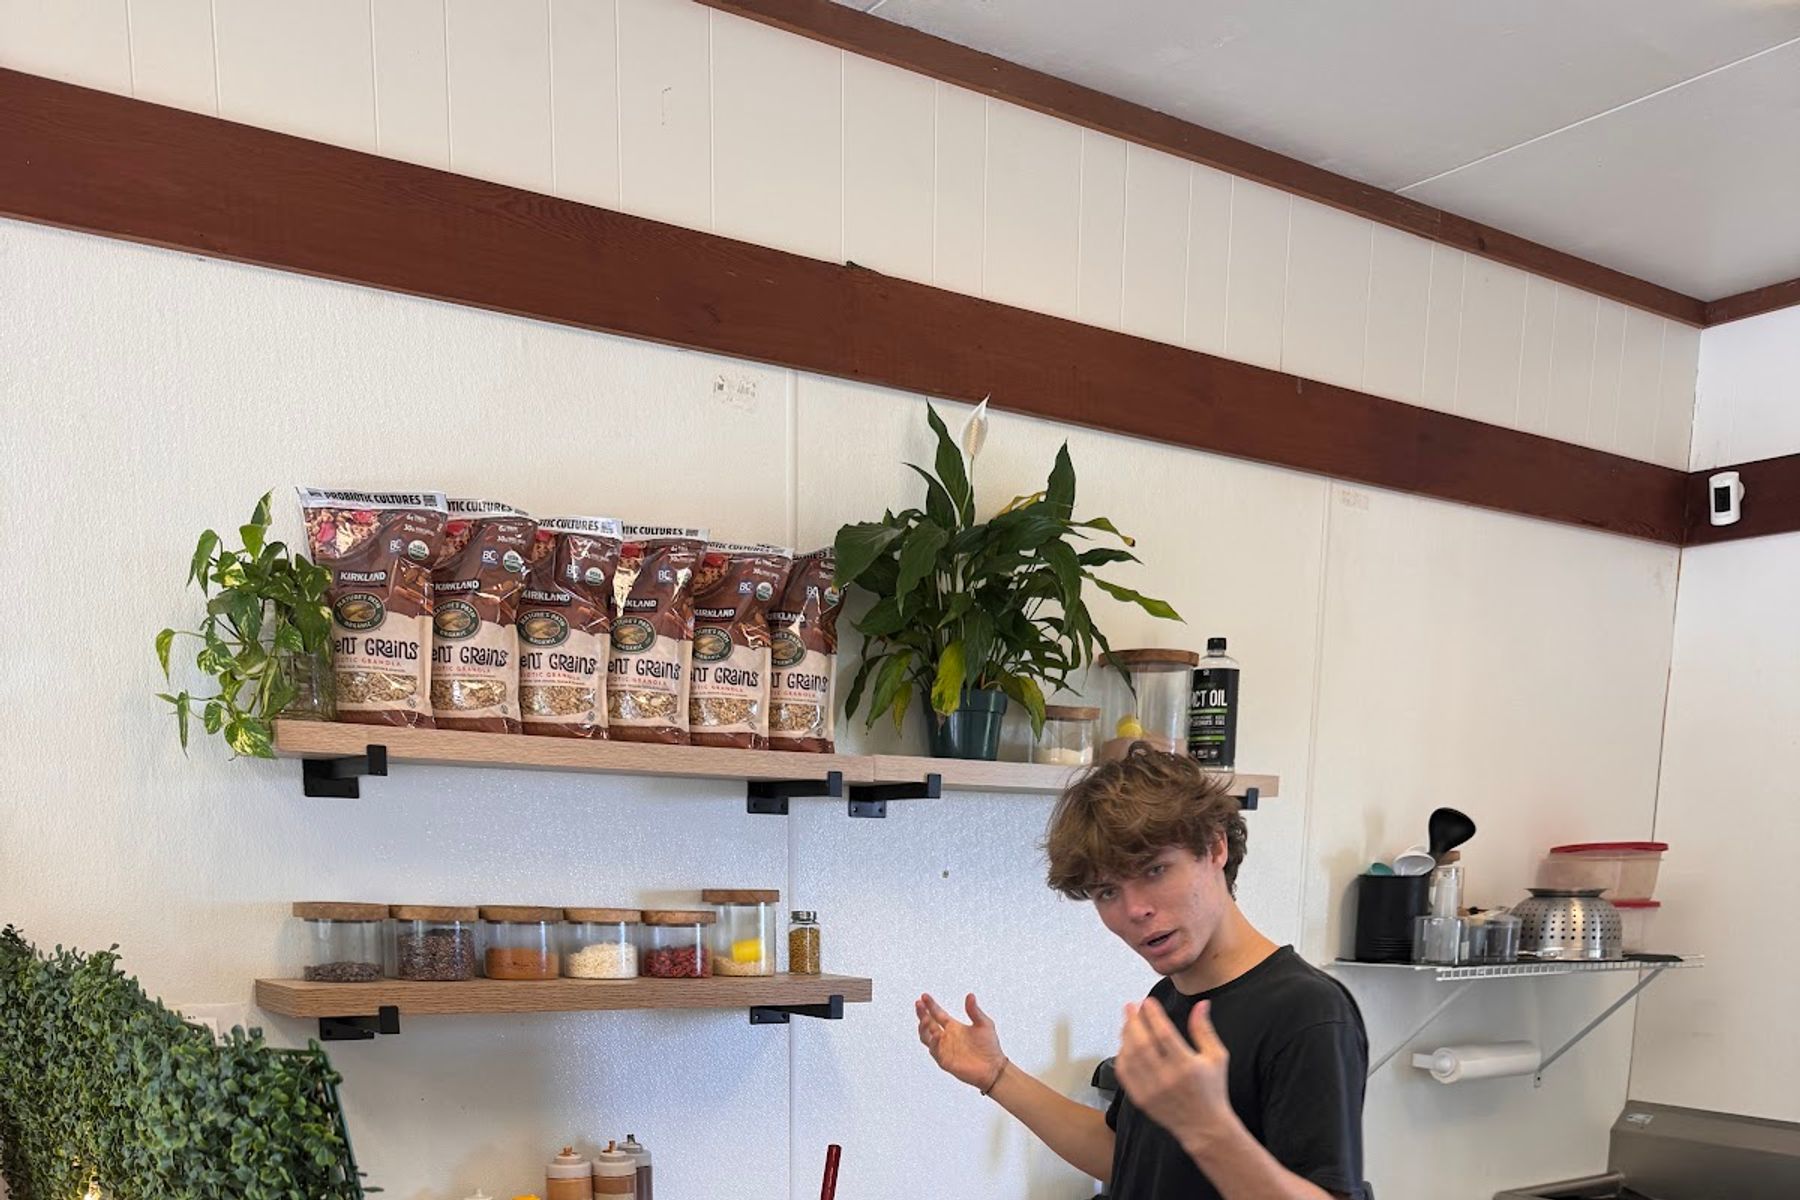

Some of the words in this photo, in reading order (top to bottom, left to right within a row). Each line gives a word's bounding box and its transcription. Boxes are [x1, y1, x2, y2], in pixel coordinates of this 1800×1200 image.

[374, 493, 421, 505] CULTURES
[466, 501, 513, 512] CULTURES
[556, 519, 599, 531] CULTURES
[639, 526, 684, 535] CULTURES
[340, 571, 387, 581] KIRKLAND
[435, 580, 479, 591] KIRKLAND
[522, 590, 570, 601] KIRKLAND
[1209, 689, 1228, 707] OIL
